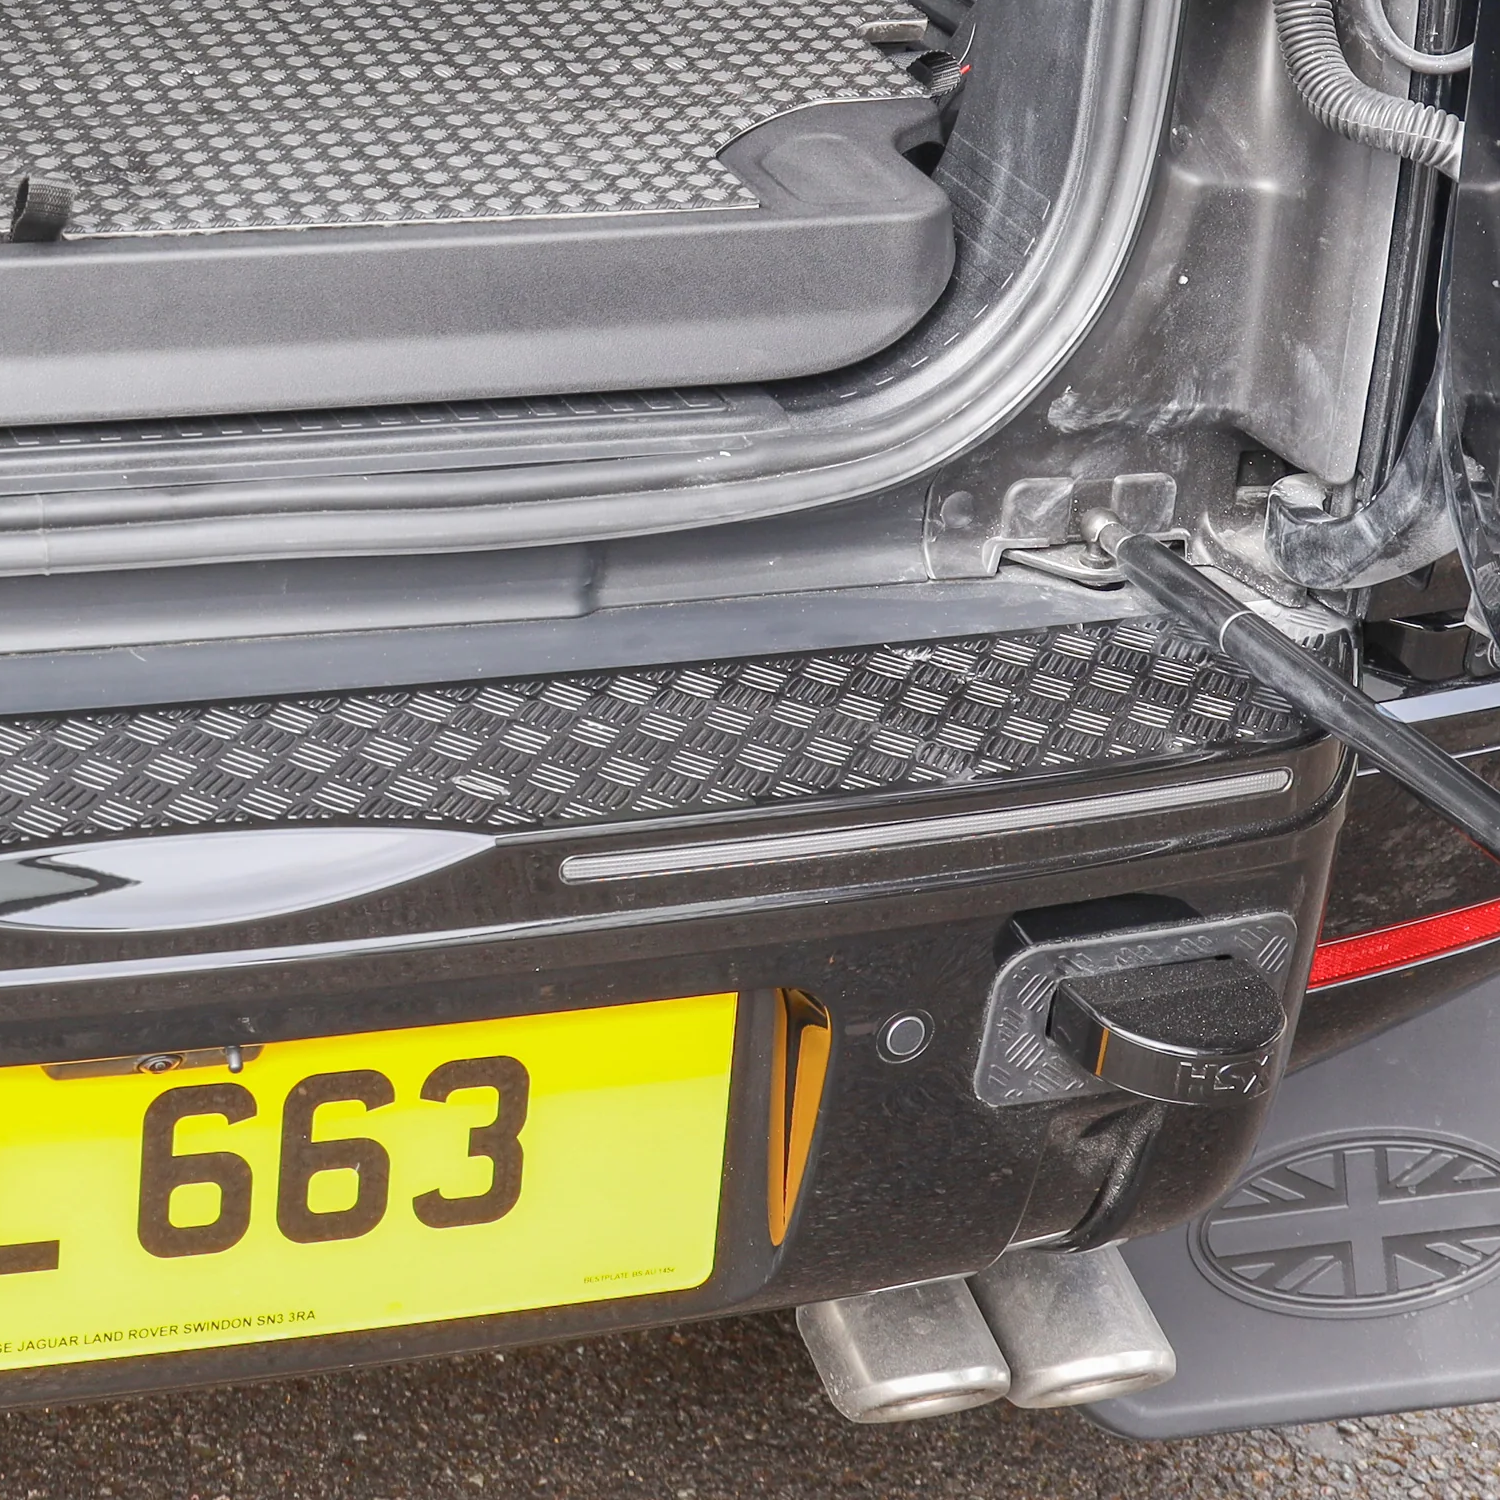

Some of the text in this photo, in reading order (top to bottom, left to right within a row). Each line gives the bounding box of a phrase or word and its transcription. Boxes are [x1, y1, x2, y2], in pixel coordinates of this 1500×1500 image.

[137, 1055, 531, 1259] 663
[17, 1335, 79, 1352] JAGUAR
[84, 1330, 124, 1345] LAND
[128, 1324, 179, 1340] ROVER
[183, 1316, 252, 1334] SWINDON
[257, 1313, 284, 1327] SN3
[288, 1309, 316, 1323] 3RA
